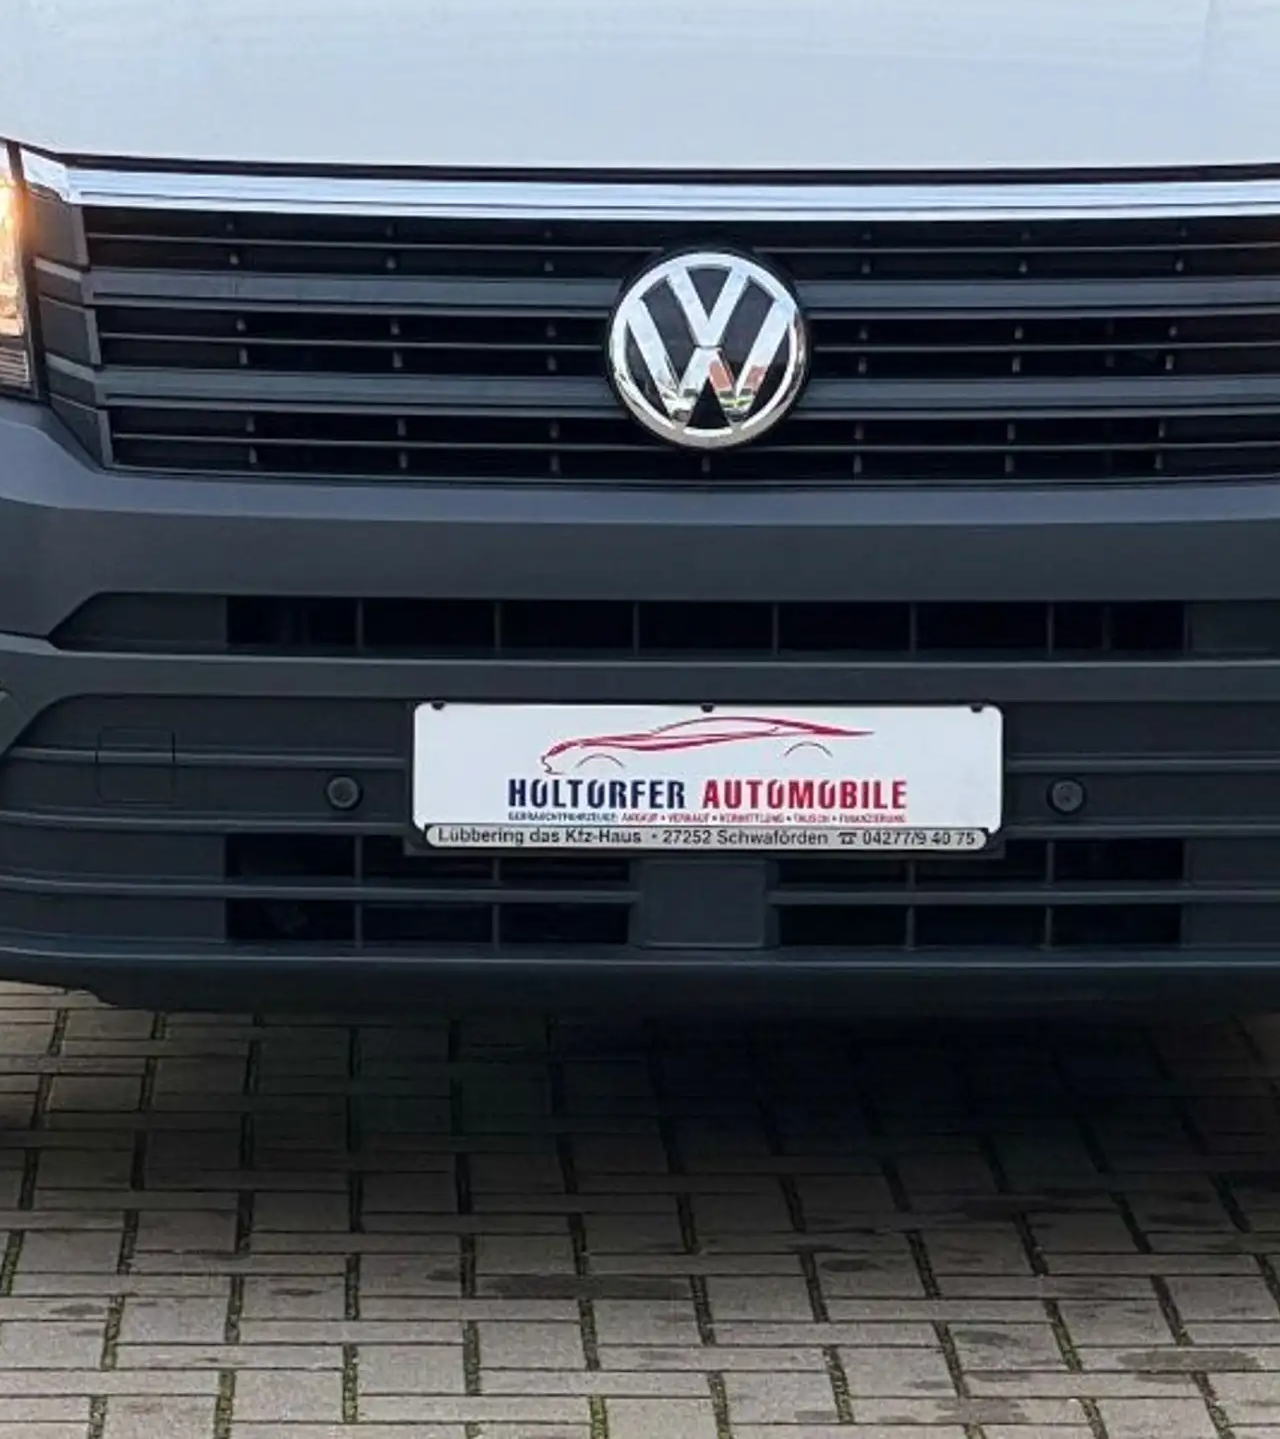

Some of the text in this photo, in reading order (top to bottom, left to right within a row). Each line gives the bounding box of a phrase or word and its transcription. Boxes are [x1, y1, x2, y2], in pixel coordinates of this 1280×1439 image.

[617, 259, 799, 438] VW
[507, 778, 908, 810] HOLTORFER AUTOMOBILE
[437, 827, 976, 846] Lübbering das Kfz-Haus 27252 Schwaförden 04277/9 40 75
